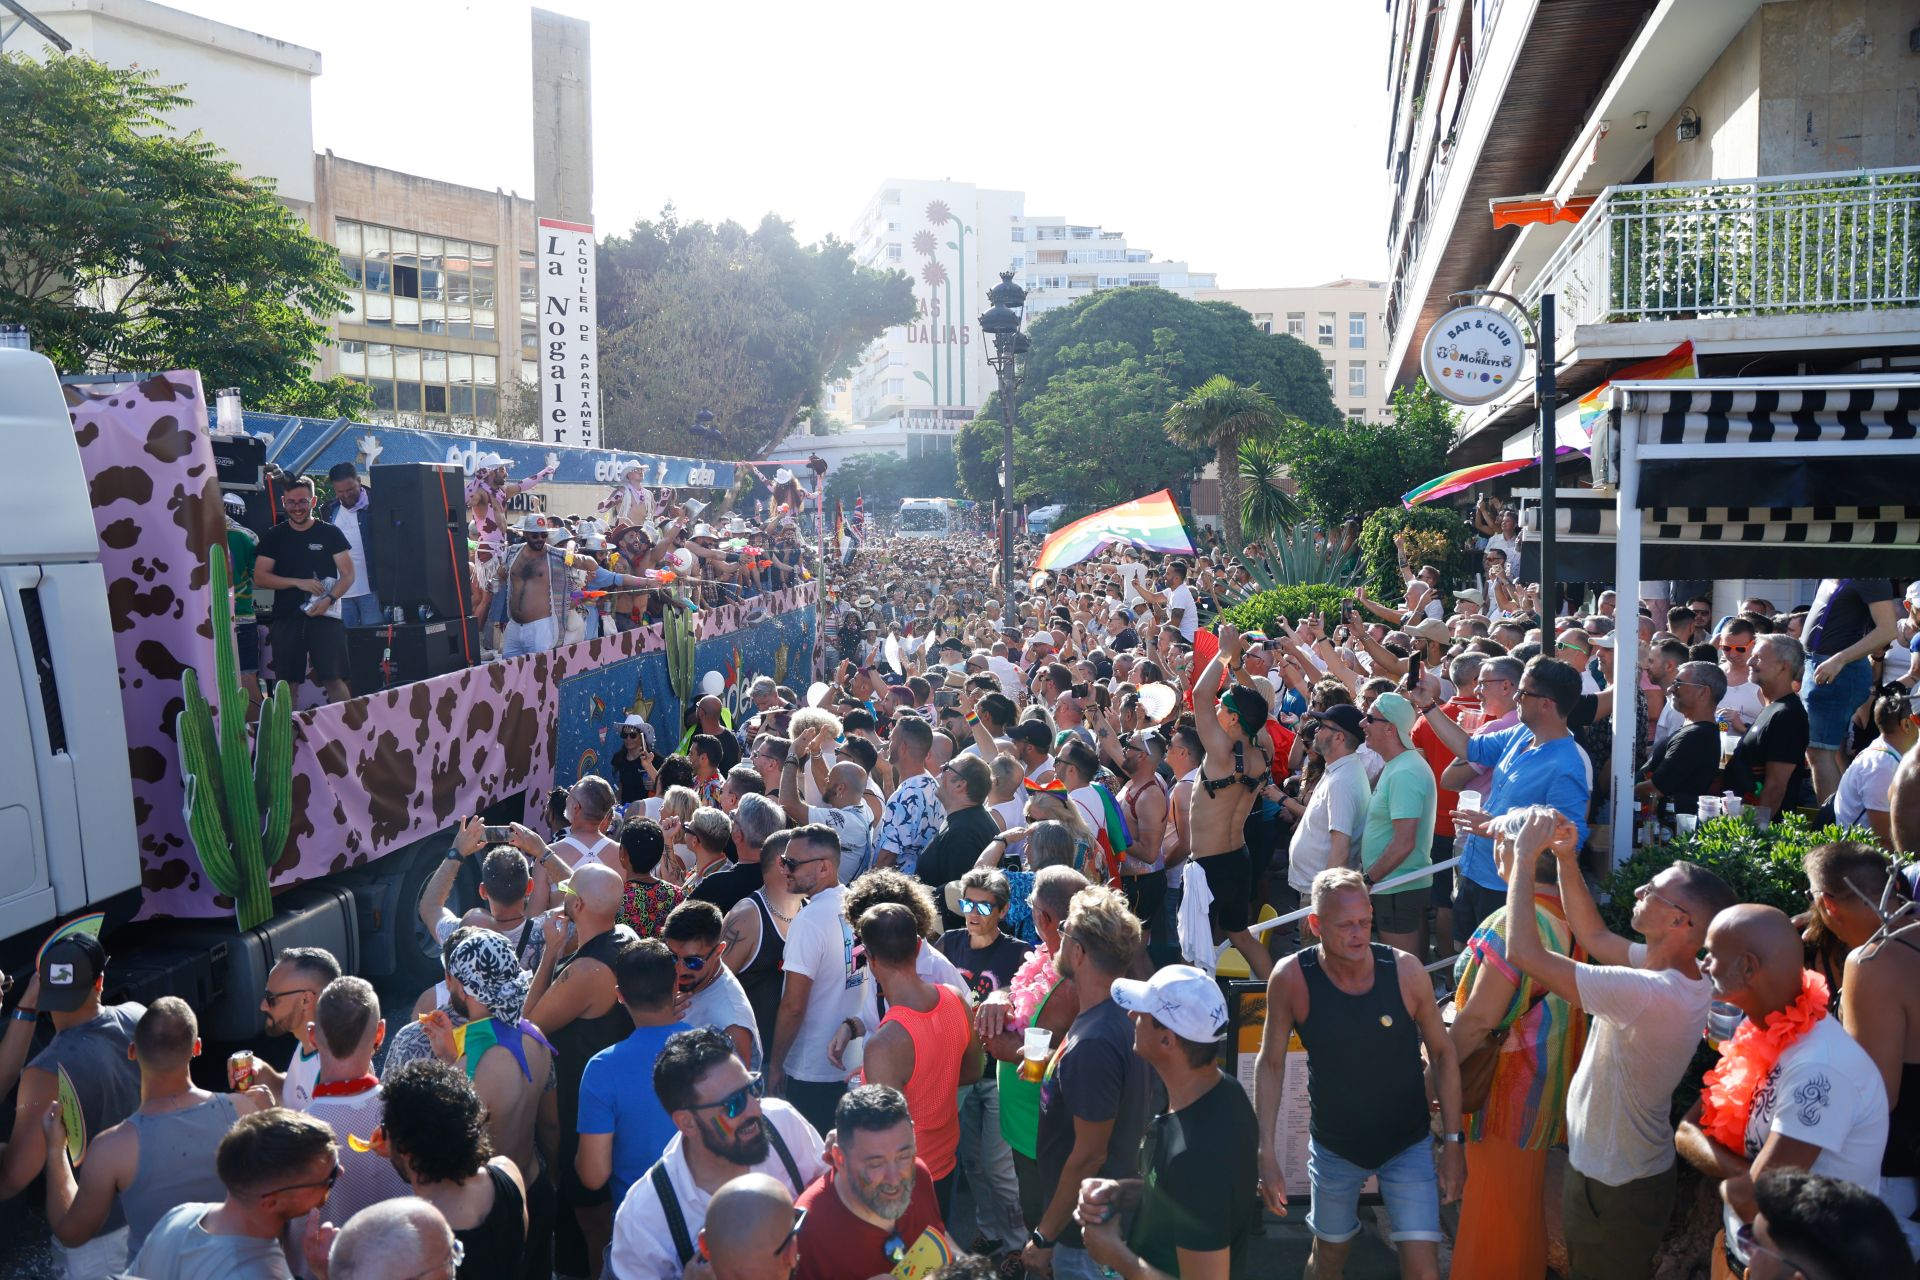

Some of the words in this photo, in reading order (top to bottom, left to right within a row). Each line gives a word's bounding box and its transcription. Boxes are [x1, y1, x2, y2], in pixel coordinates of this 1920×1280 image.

[546, 236, 565, 276] La
[577, 238, 589, 313] ALQUILER
[920, 298, 941, 318] AS
[580, 325, 589, 341] DE
[907, 324, 970, 345] DALIAS
[1447, 321, 1471, 339] BAR
[1475, 319, 1484, 328] &
[1487, 323, 1512, 346] CLUB
[545, 296, 571, 443] Nogaler
[580, 353, 592, 446] APARTAMENT
[595, 454, 628, 481] ede
[688, 462, 715, 485] eden
